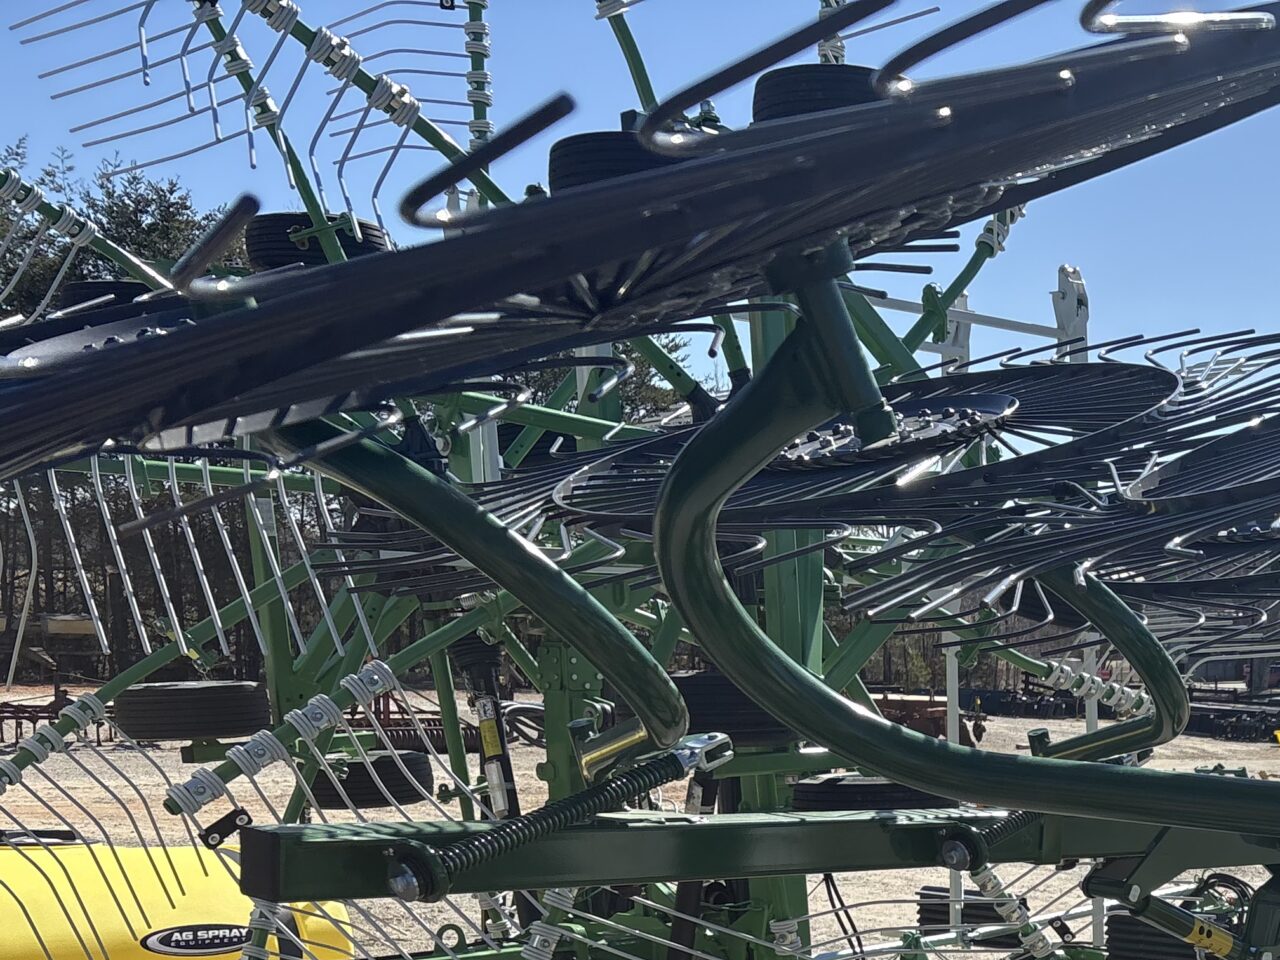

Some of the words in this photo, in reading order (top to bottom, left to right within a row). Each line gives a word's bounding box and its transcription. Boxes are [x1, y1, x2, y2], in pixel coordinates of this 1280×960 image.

[171, 931, 193, 941] AG
[197, 928, 249, 939] SPRAY
[171, 937, 246, 947] EQUIPMENT
